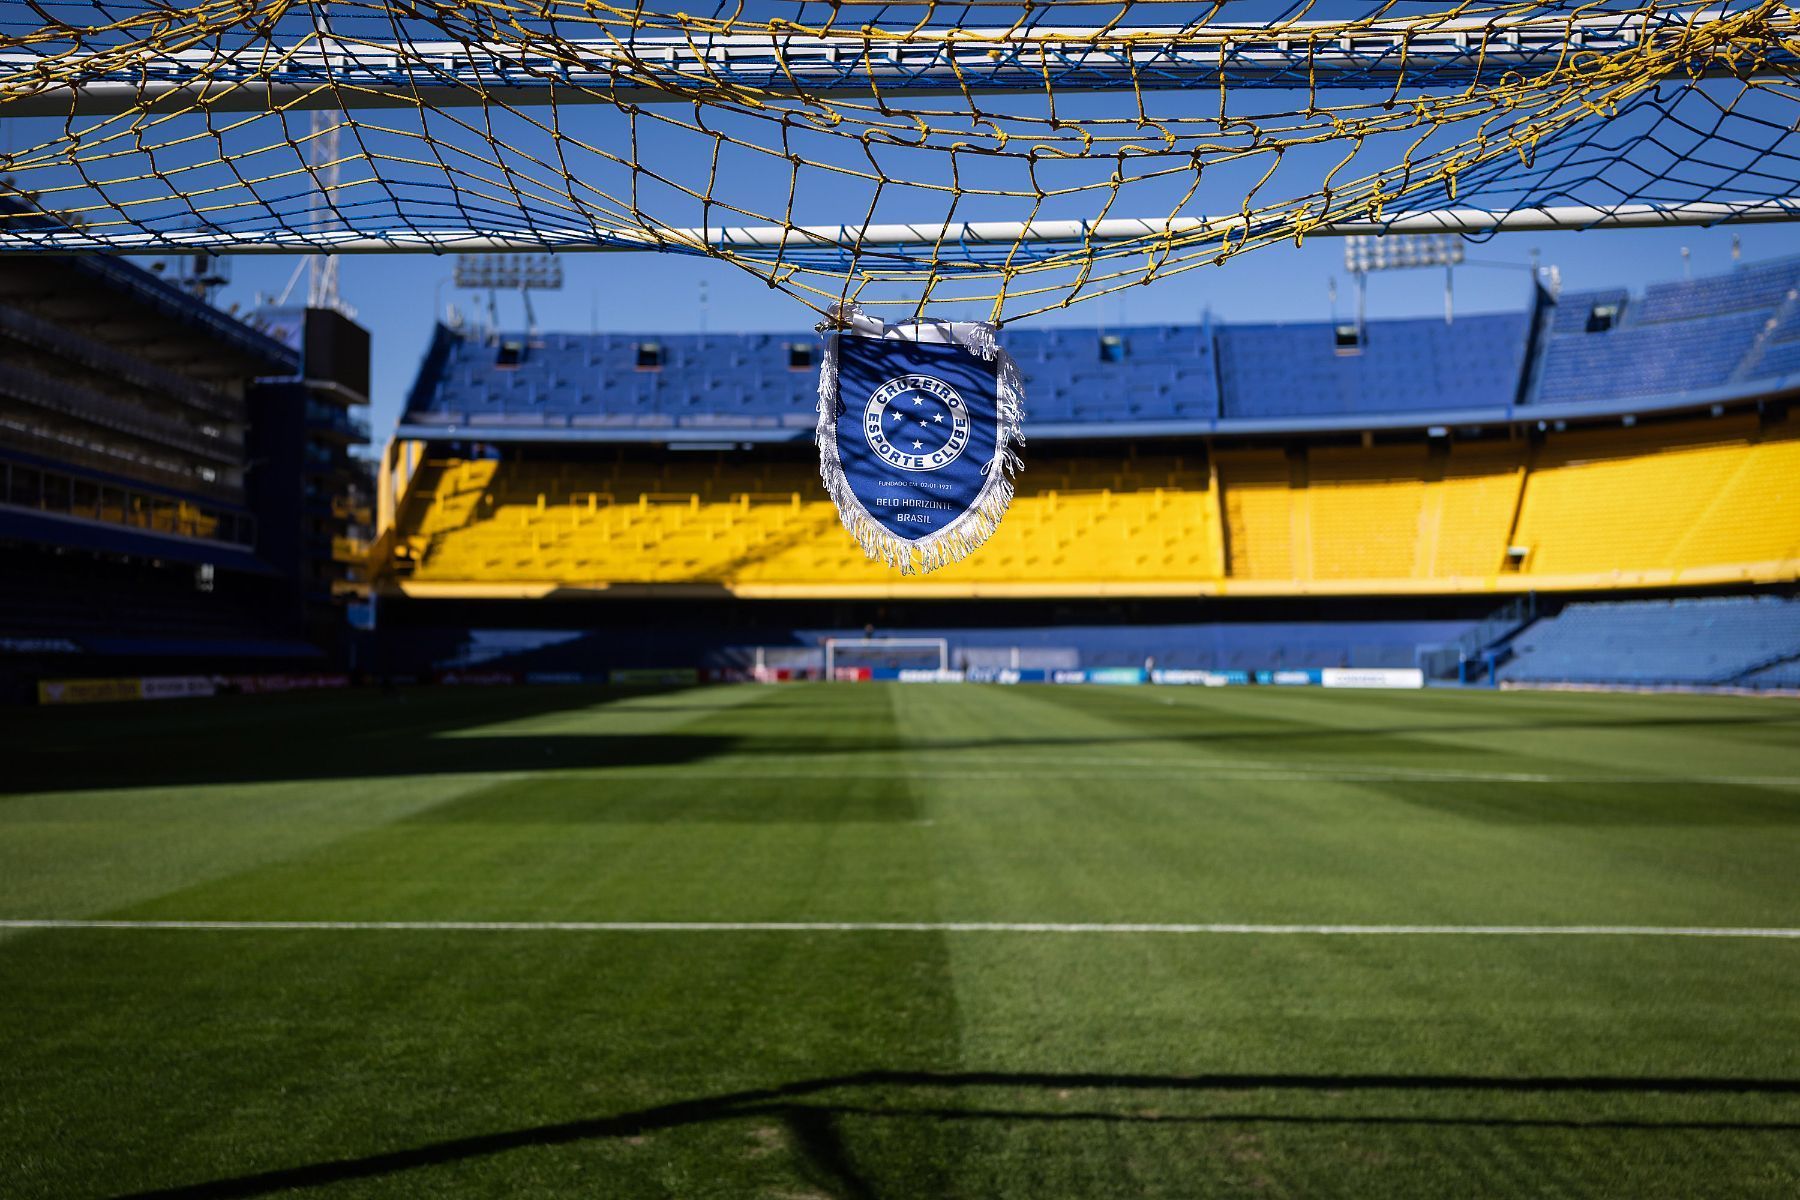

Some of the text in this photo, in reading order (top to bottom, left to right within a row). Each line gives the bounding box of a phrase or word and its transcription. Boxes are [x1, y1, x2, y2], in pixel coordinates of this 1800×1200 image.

[876, 378, 960, 409] CRUZEIRO
[868, 412, 966, 468] ESPORTE CLUBE
[876, 498, 953, 511] BELO HORIZONTE
[897, 513, 932, 524] BRASIL
